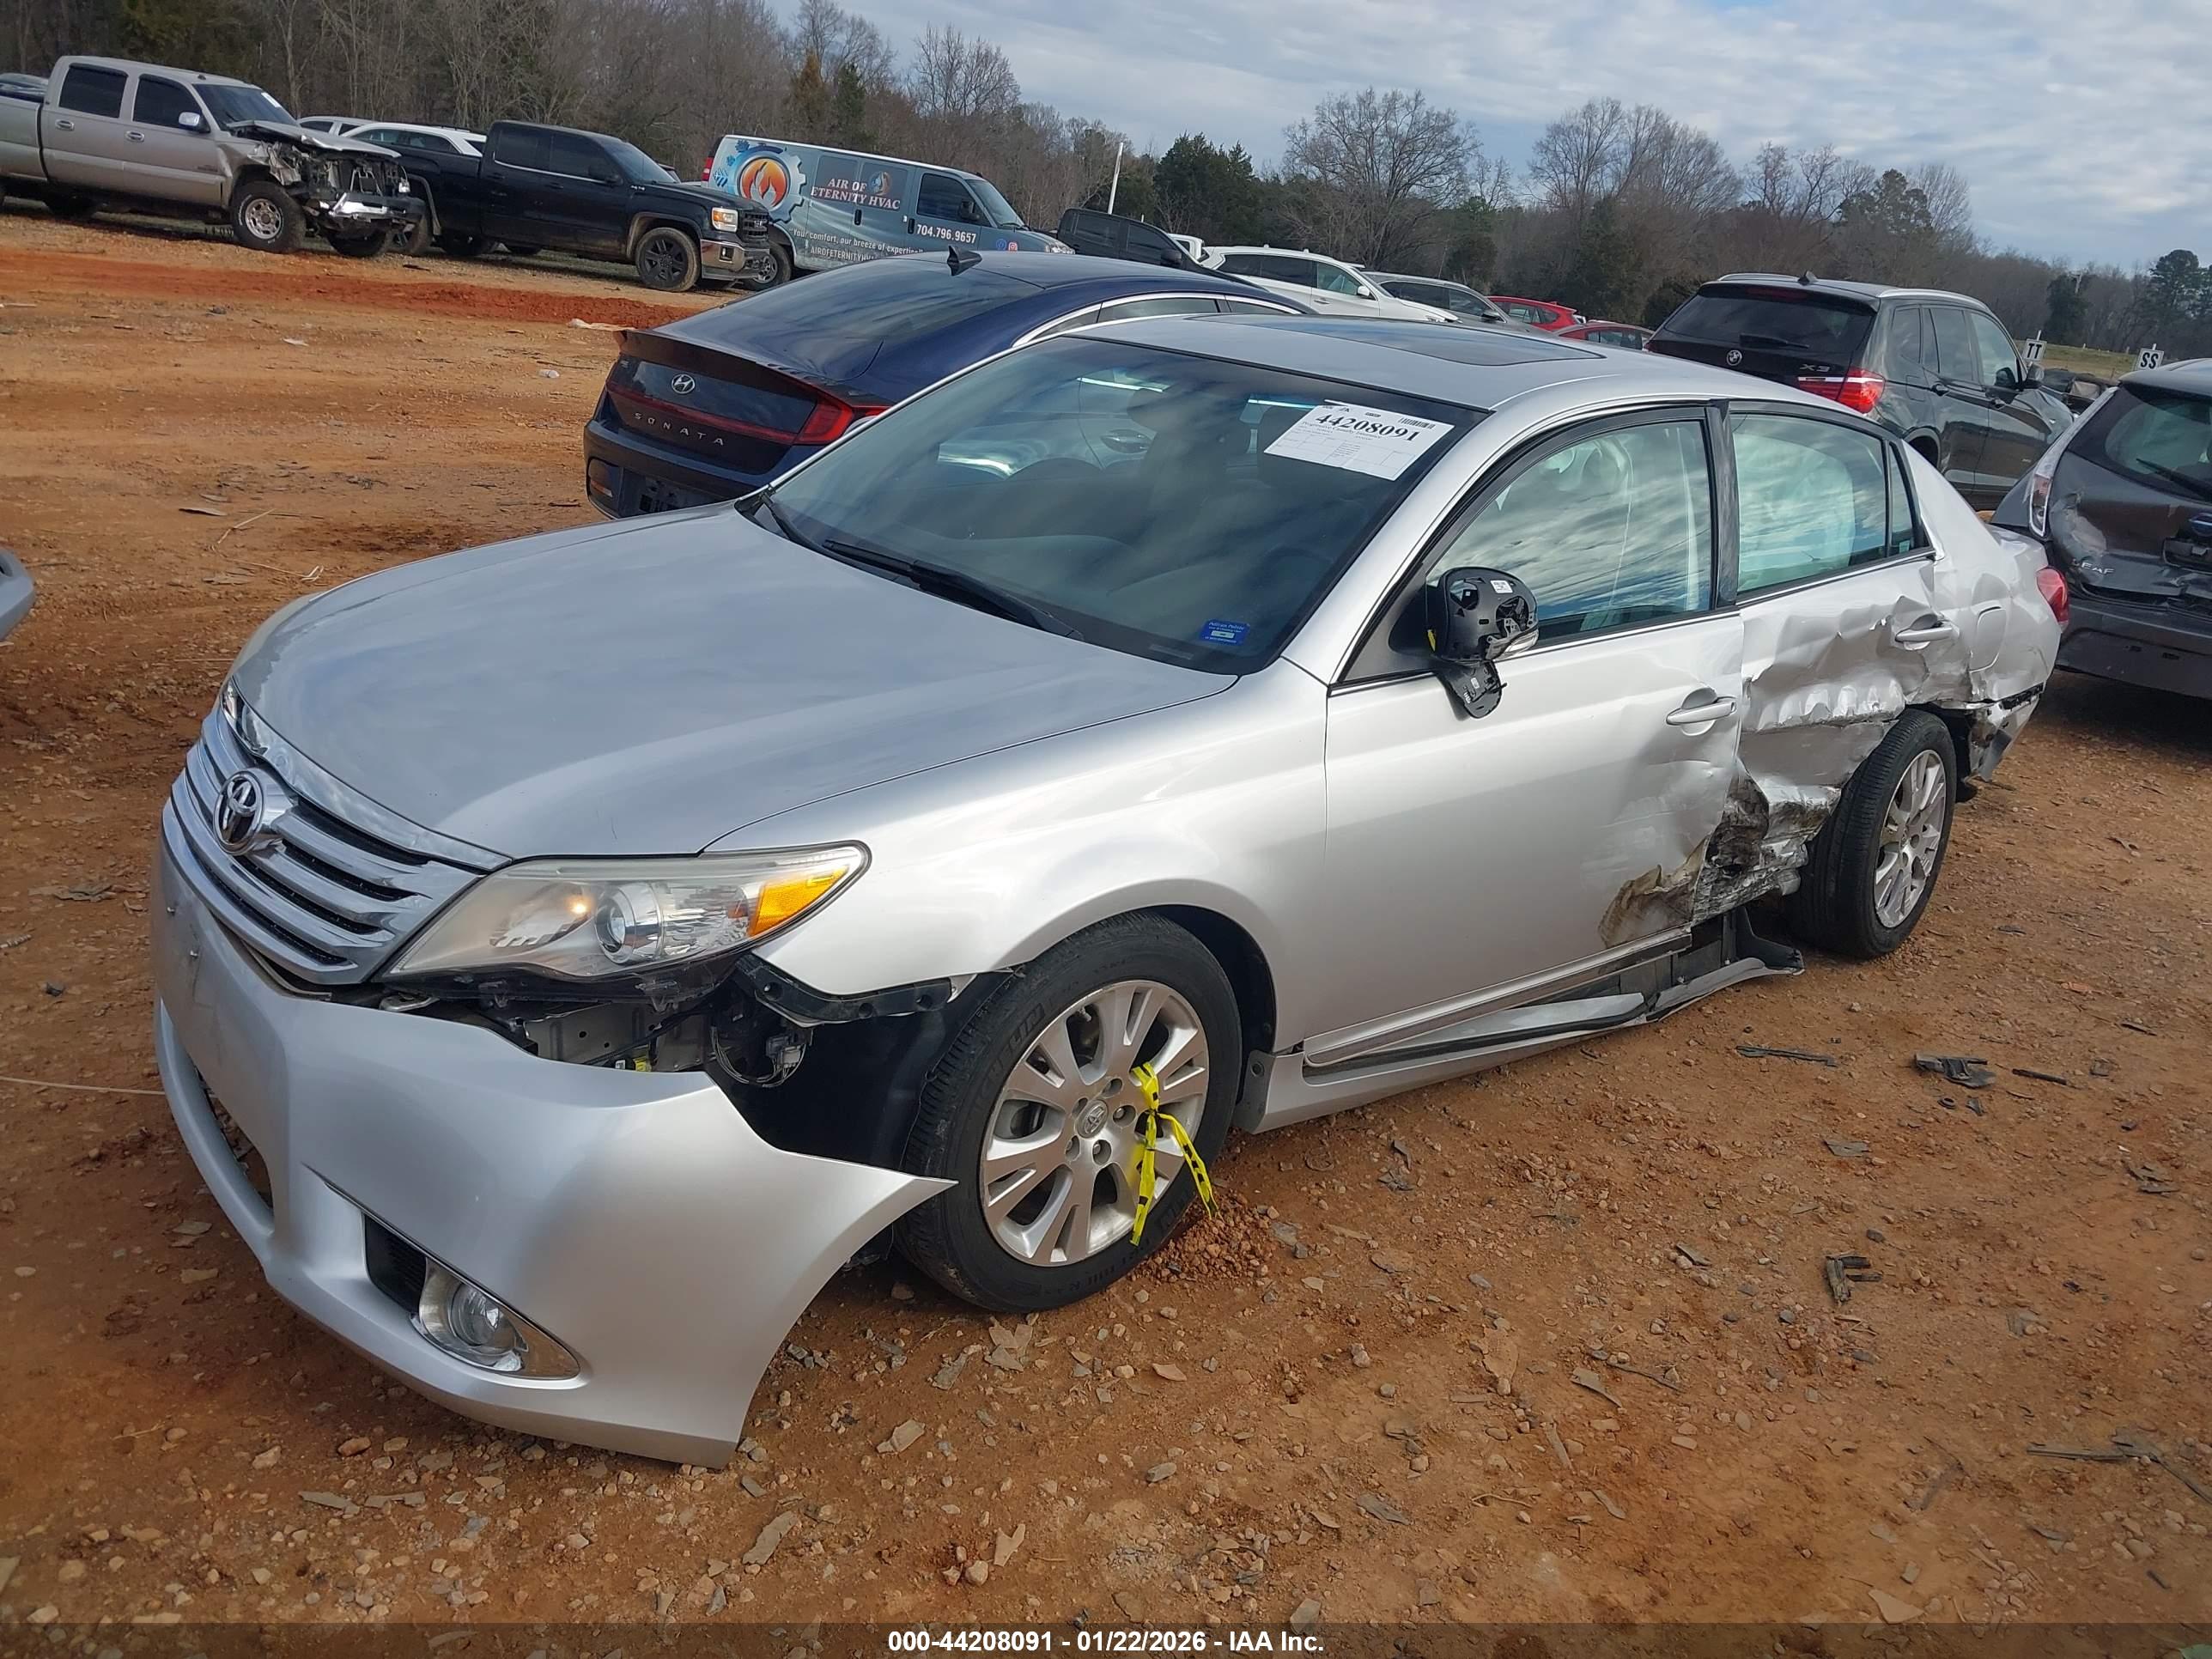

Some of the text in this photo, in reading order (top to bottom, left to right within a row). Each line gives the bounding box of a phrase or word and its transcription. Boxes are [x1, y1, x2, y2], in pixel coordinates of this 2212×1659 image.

[828, 178, 867, 192] AIR OF
[810, 186, 901, 210] ETERNITY HVAC
[915, 224, 977, 244] 704.796.9657
[840, 237, 852, 246] our
[853, 238, 876, 249] breeze
[2027, 343, 2042, 359] TT
[1799, 363, 1830, 373] X3
[2140, 352, 2159, 369] SS
[634, 414, 725, 447] SONATA
[1315, 414, 1420, 441] 44208091
